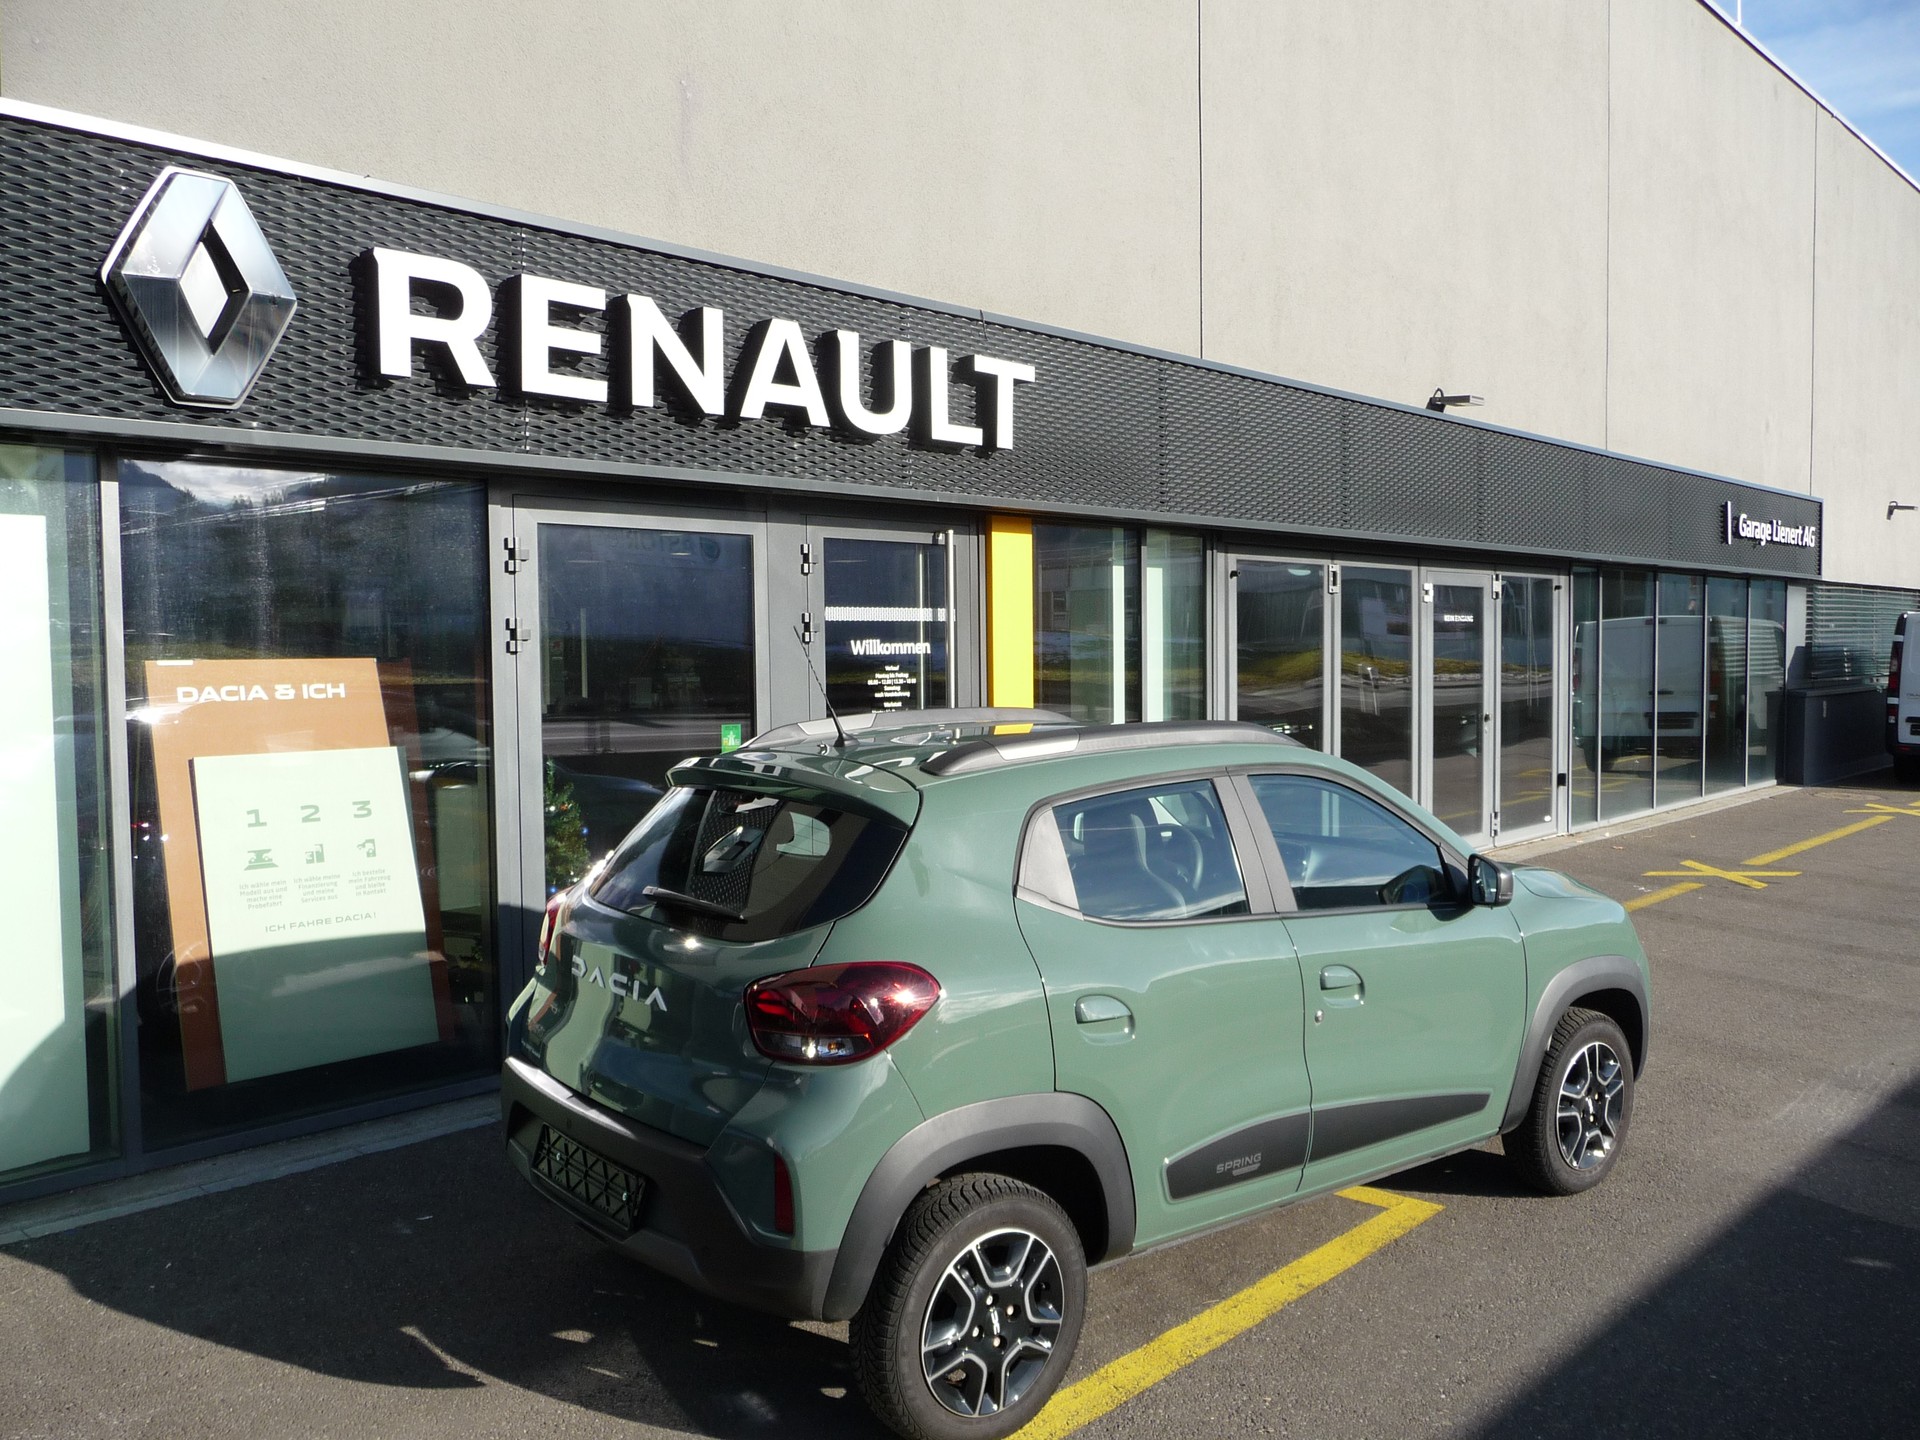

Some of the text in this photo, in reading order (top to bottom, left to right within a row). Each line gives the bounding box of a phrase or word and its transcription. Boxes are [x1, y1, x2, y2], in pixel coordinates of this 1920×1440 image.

[372, 246, 1036, 451] RENAULT
[1738, 513, 1816, 547] Garage Lienert AG
[850, 638, 932, 656] Willkommen
[175, 683, 347, 704] DACIA & ICH
[246, 800, 373, 828] 1 2 3
[265, 923, 286, 933] ICH
[289, 917, 333, 930] FAHRE
[570, 954, 668, 1012] DACIA
[1216, 1152, 1262, 1174] SPRING
